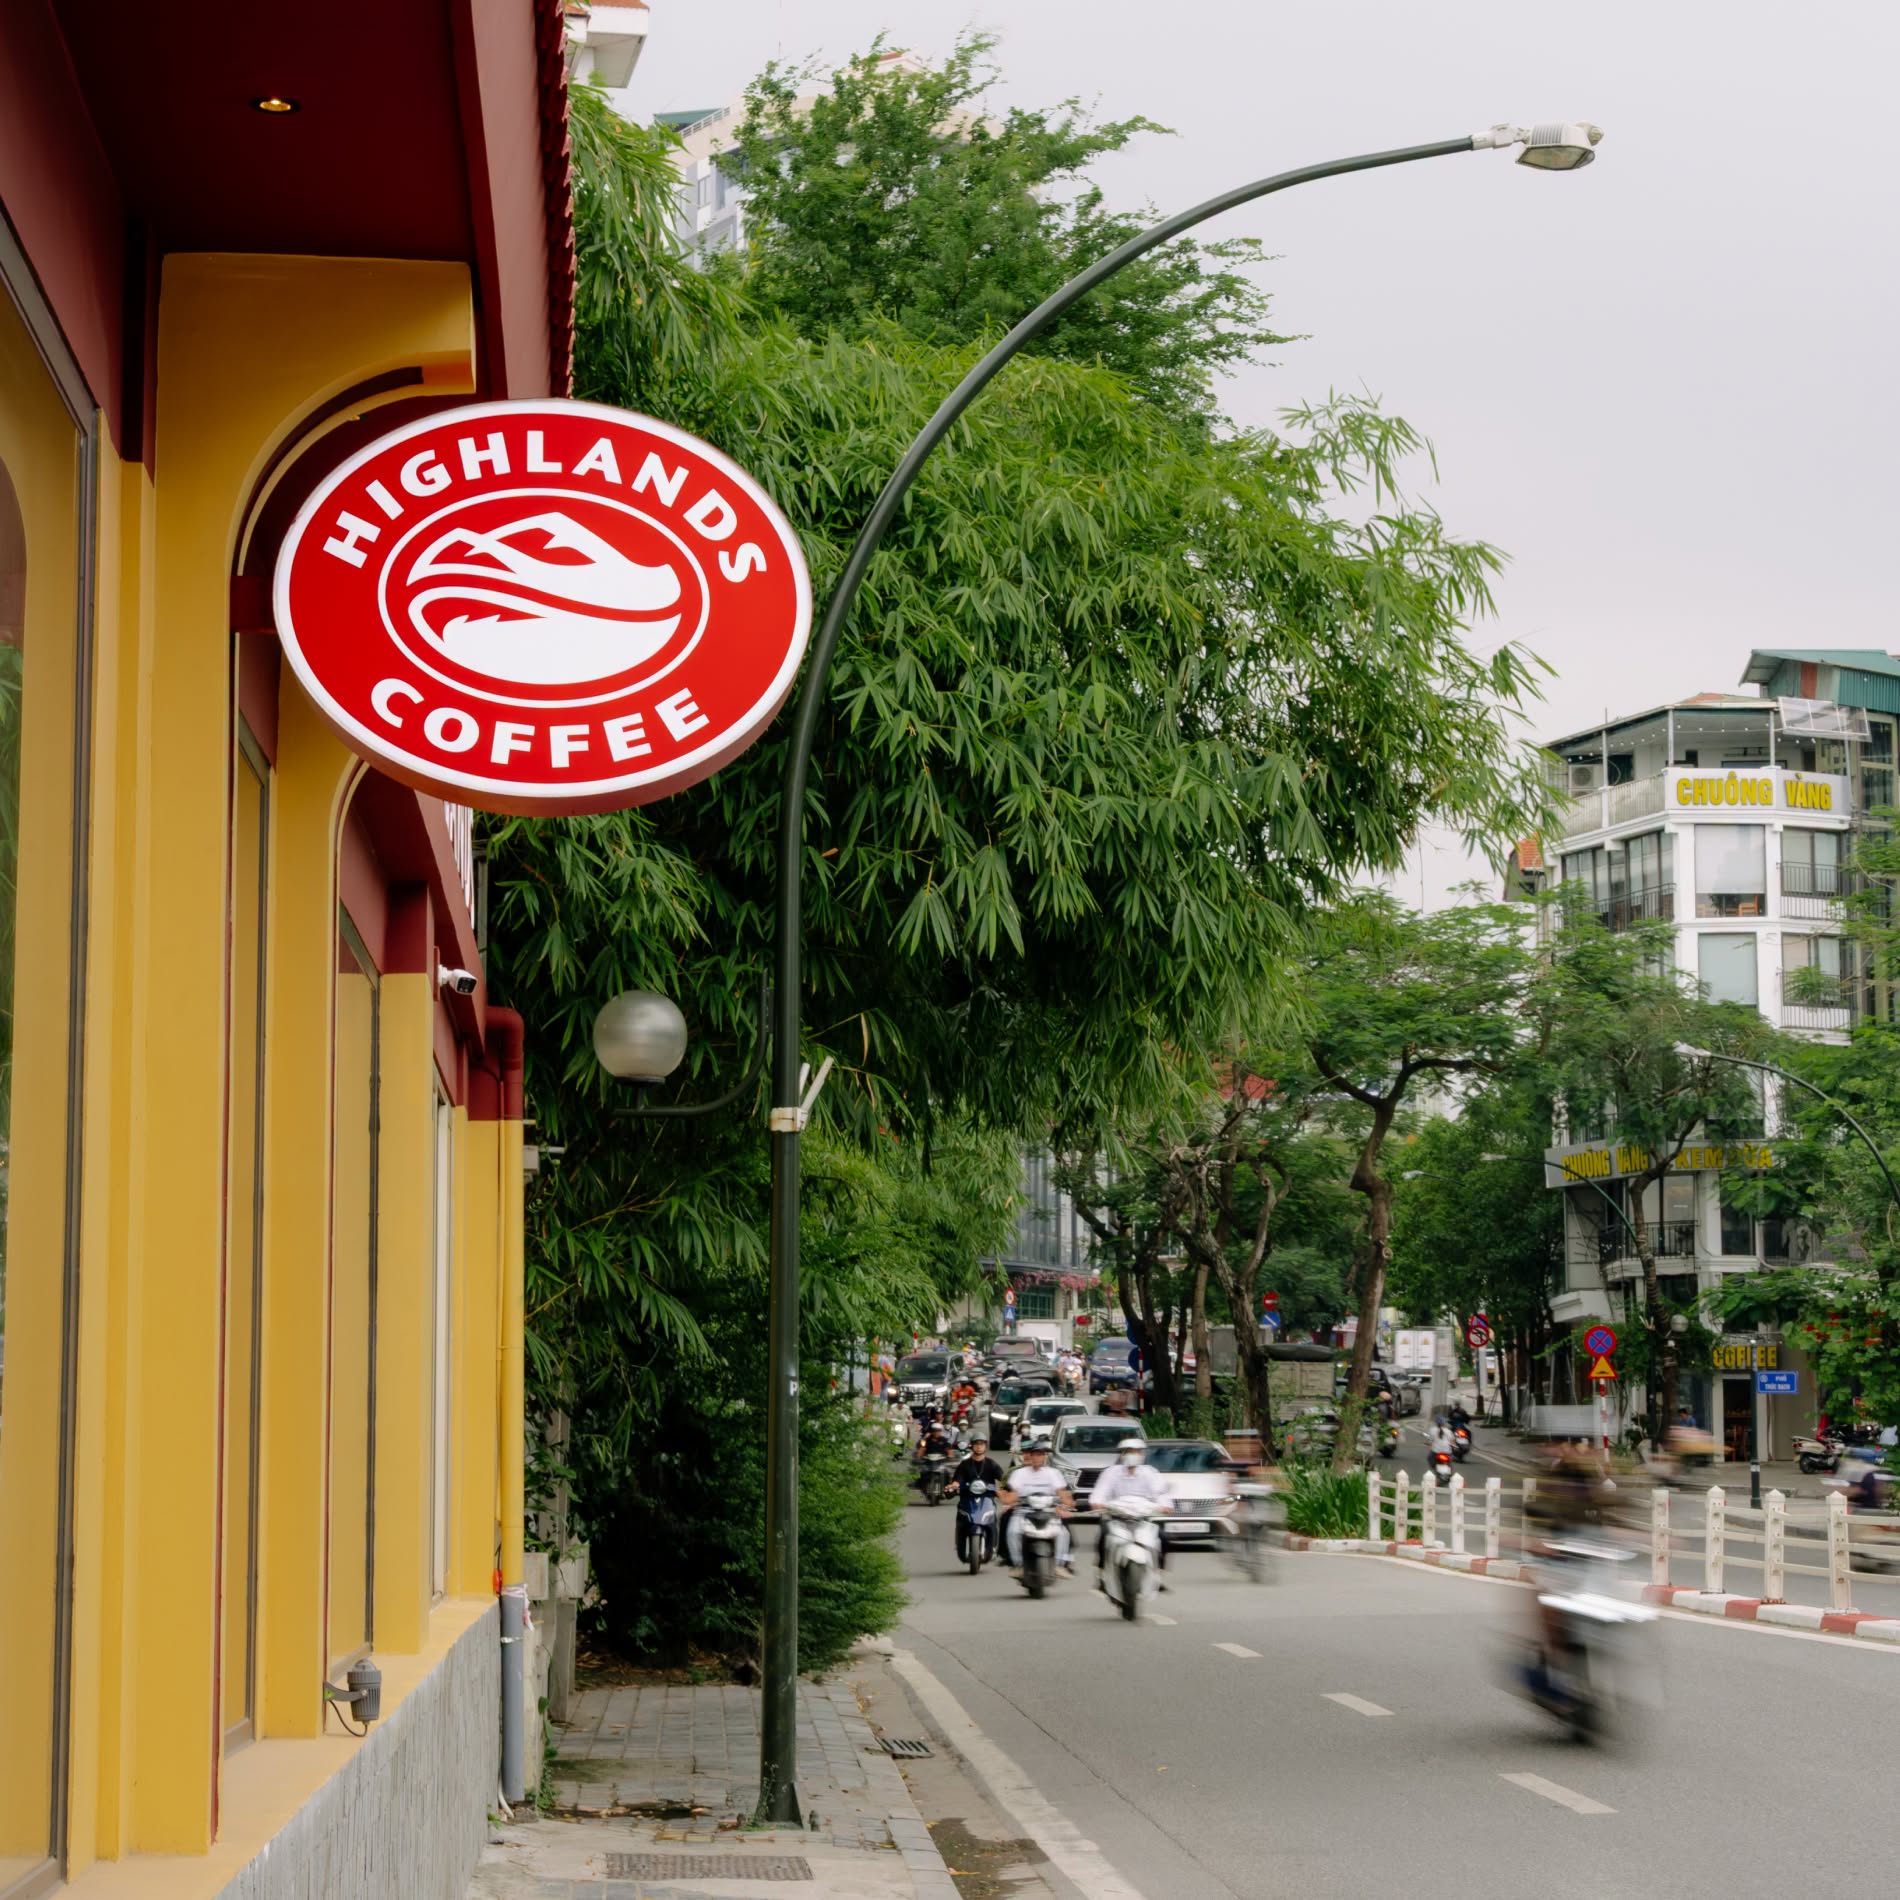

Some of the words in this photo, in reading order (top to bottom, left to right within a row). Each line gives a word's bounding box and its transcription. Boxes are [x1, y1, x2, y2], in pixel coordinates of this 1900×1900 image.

[322, 430, 767, 583] HIGHLANDS
[370, 677, 710, 768] COFFEE
[1677, 771, 1773, 806] CHUÔNG
[1786, 773, 1832, 810] VÀNG
[1675, 1146, 1723, 1169] KEM
